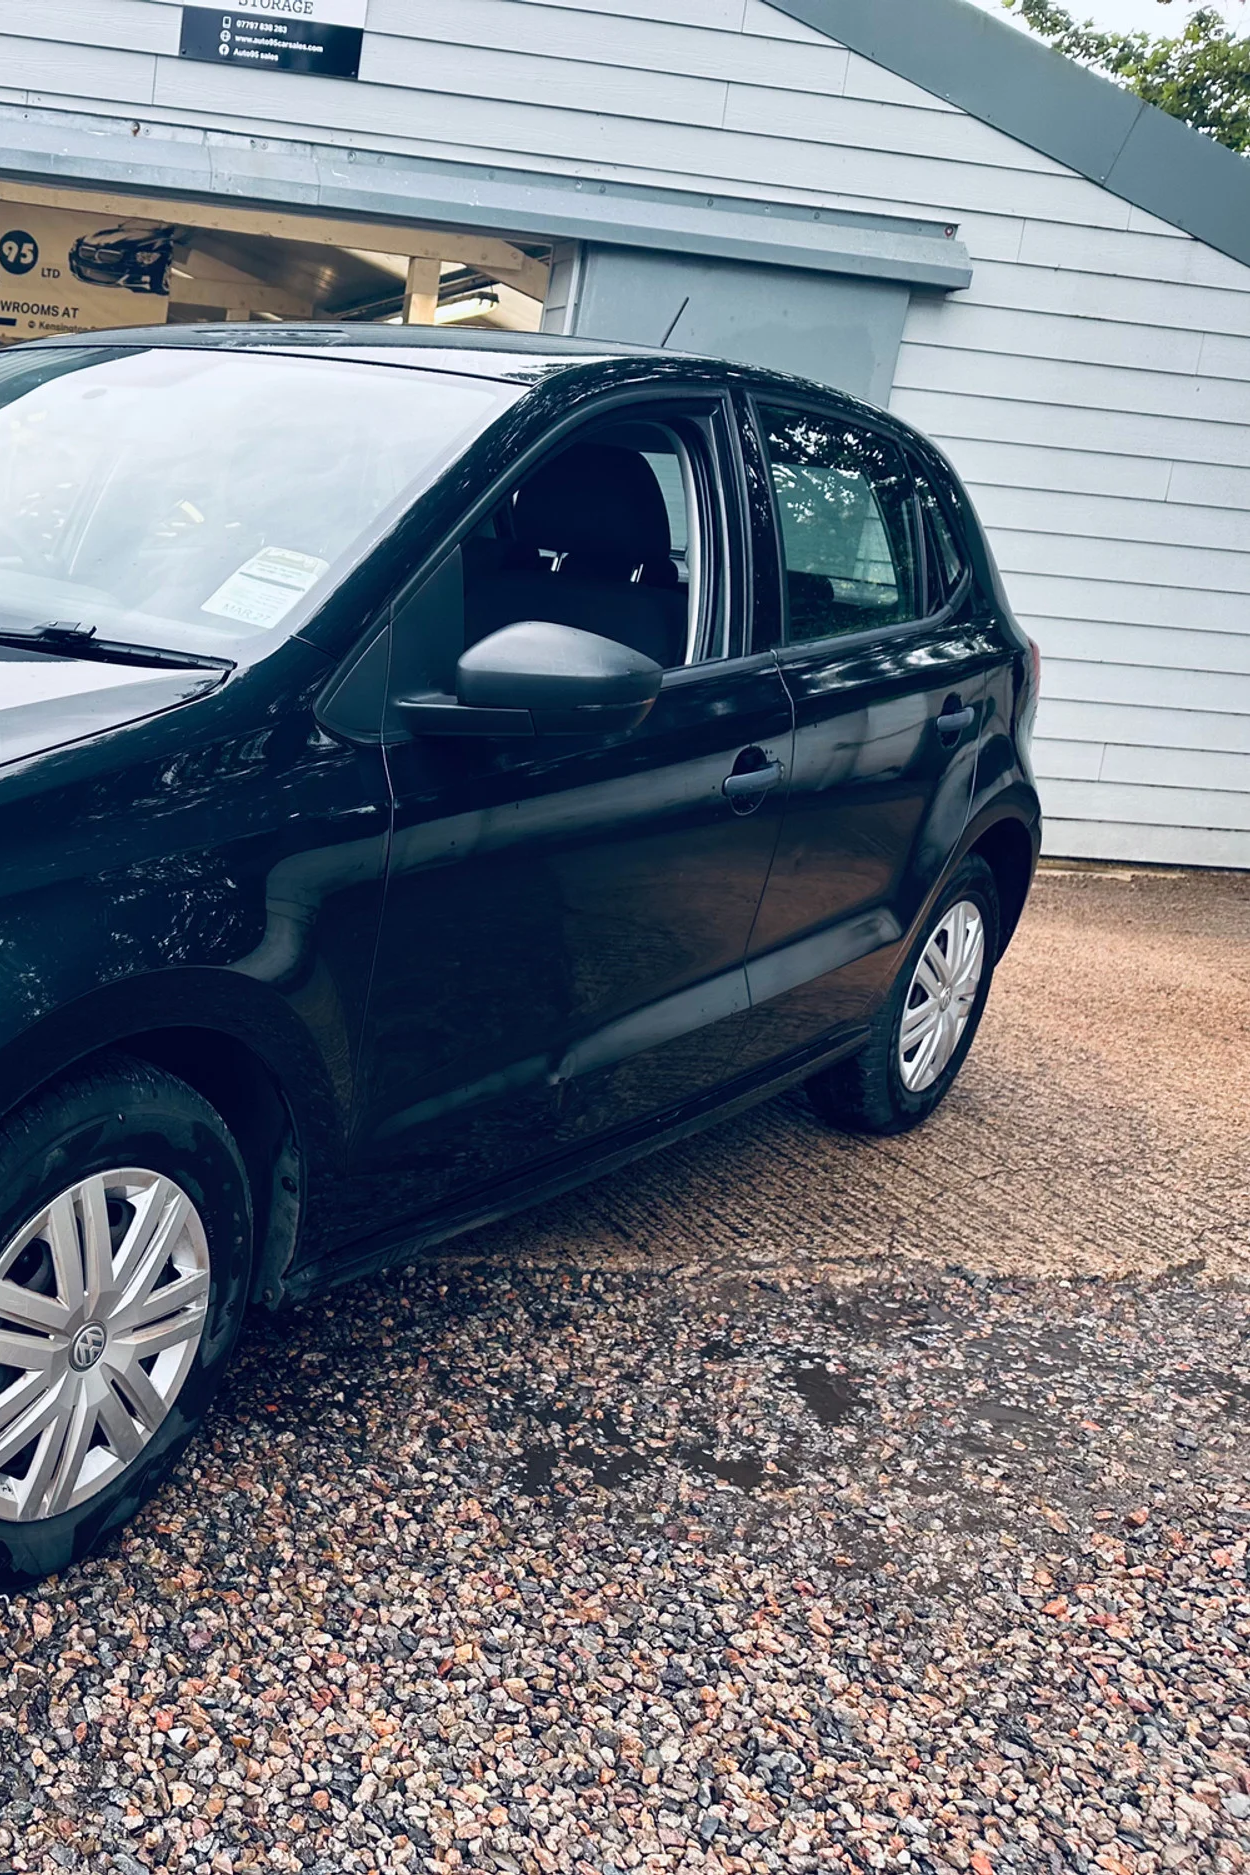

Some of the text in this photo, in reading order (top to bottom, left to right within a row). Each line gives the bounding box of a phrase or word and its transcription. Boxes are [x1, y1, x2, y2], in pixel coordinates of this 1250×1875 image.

[260, 52, 279, 62] sales
[2, 240, 34, 264] 95
[41, 267, 61, 279] LTD
[61, 306, 79, 319] AT
